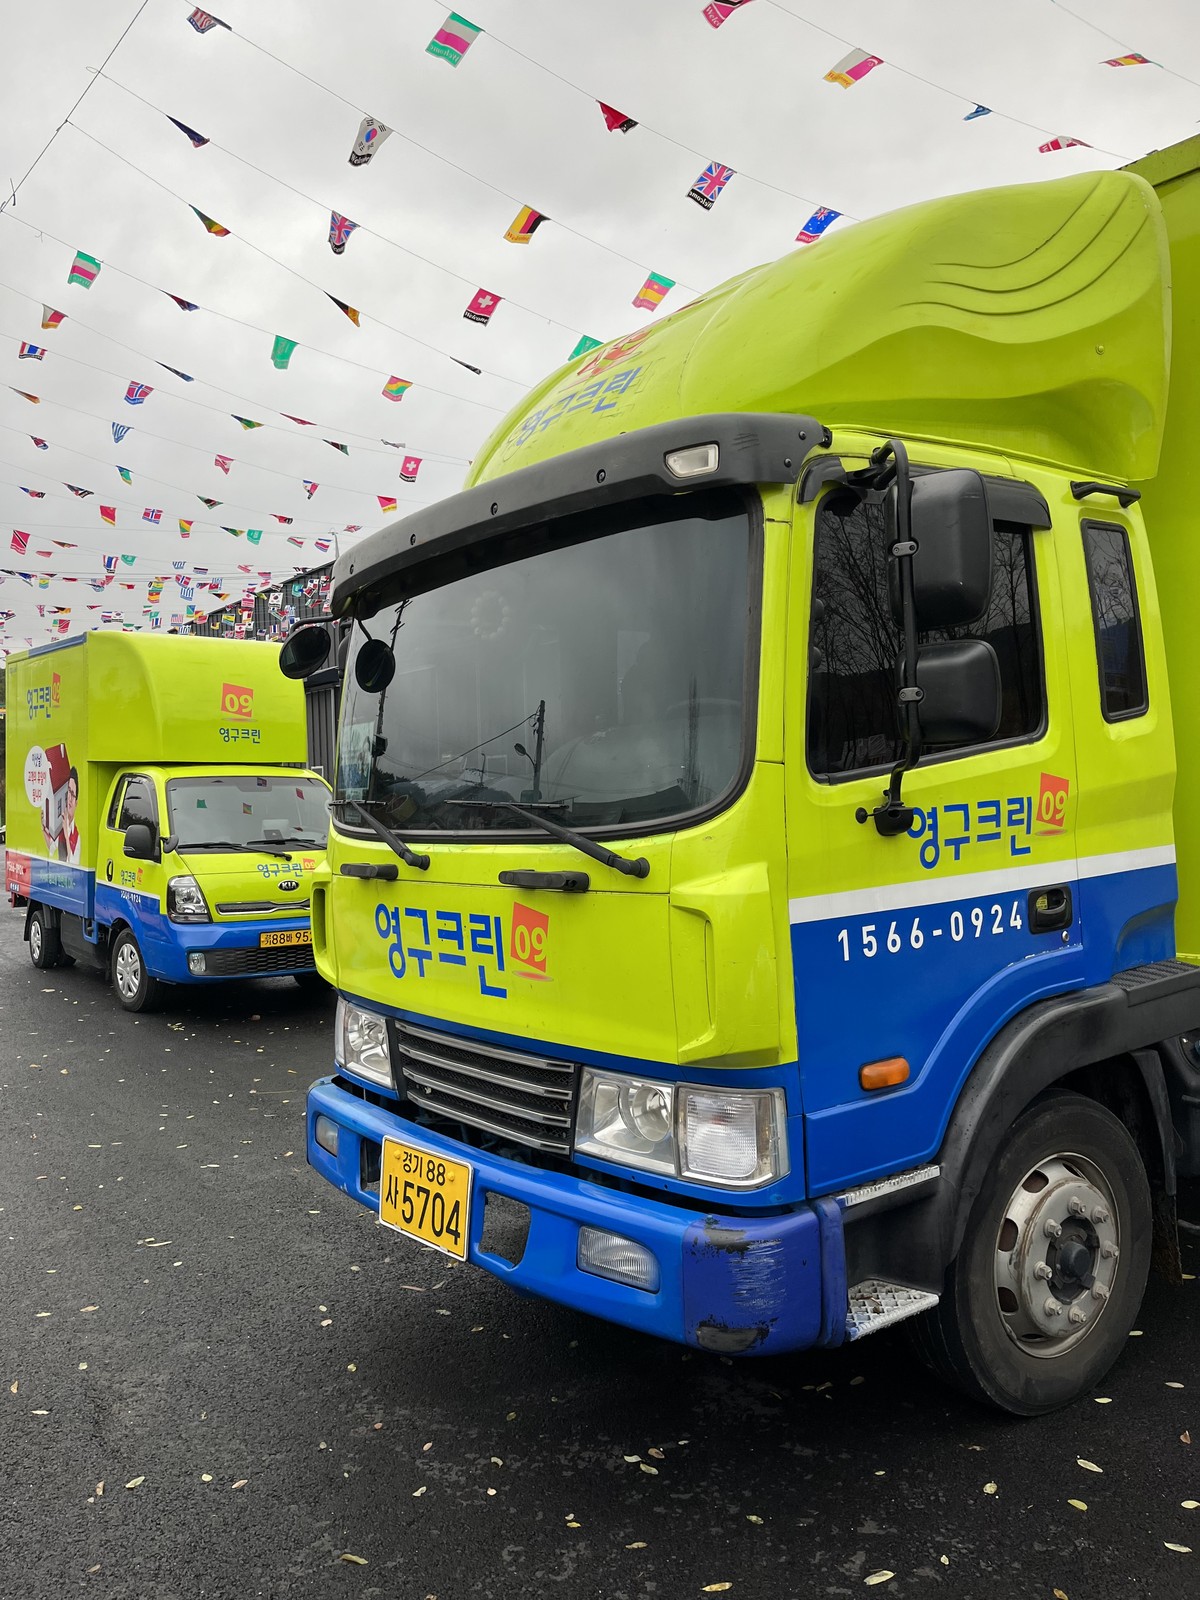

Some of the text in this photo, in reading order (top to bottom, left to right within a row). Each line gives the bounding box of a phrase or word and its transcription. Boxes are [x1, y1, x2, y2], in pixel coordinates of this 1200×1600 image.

[465, 311, 489, 323] Welcome
[27, 686, 51, 720] 영구크린
[225, 693, 254, 713] 09
[219, 727, 261, 744] 영구크린
[905, 790, 1068, 870] 영구크린 09
[257, 863, 303, 878] 영구크린
[281, 881, 297, 889] KIA
[837, 901, 1023, 962] 1566-0924
[375, 903, 547, 999] 영구크린 09
